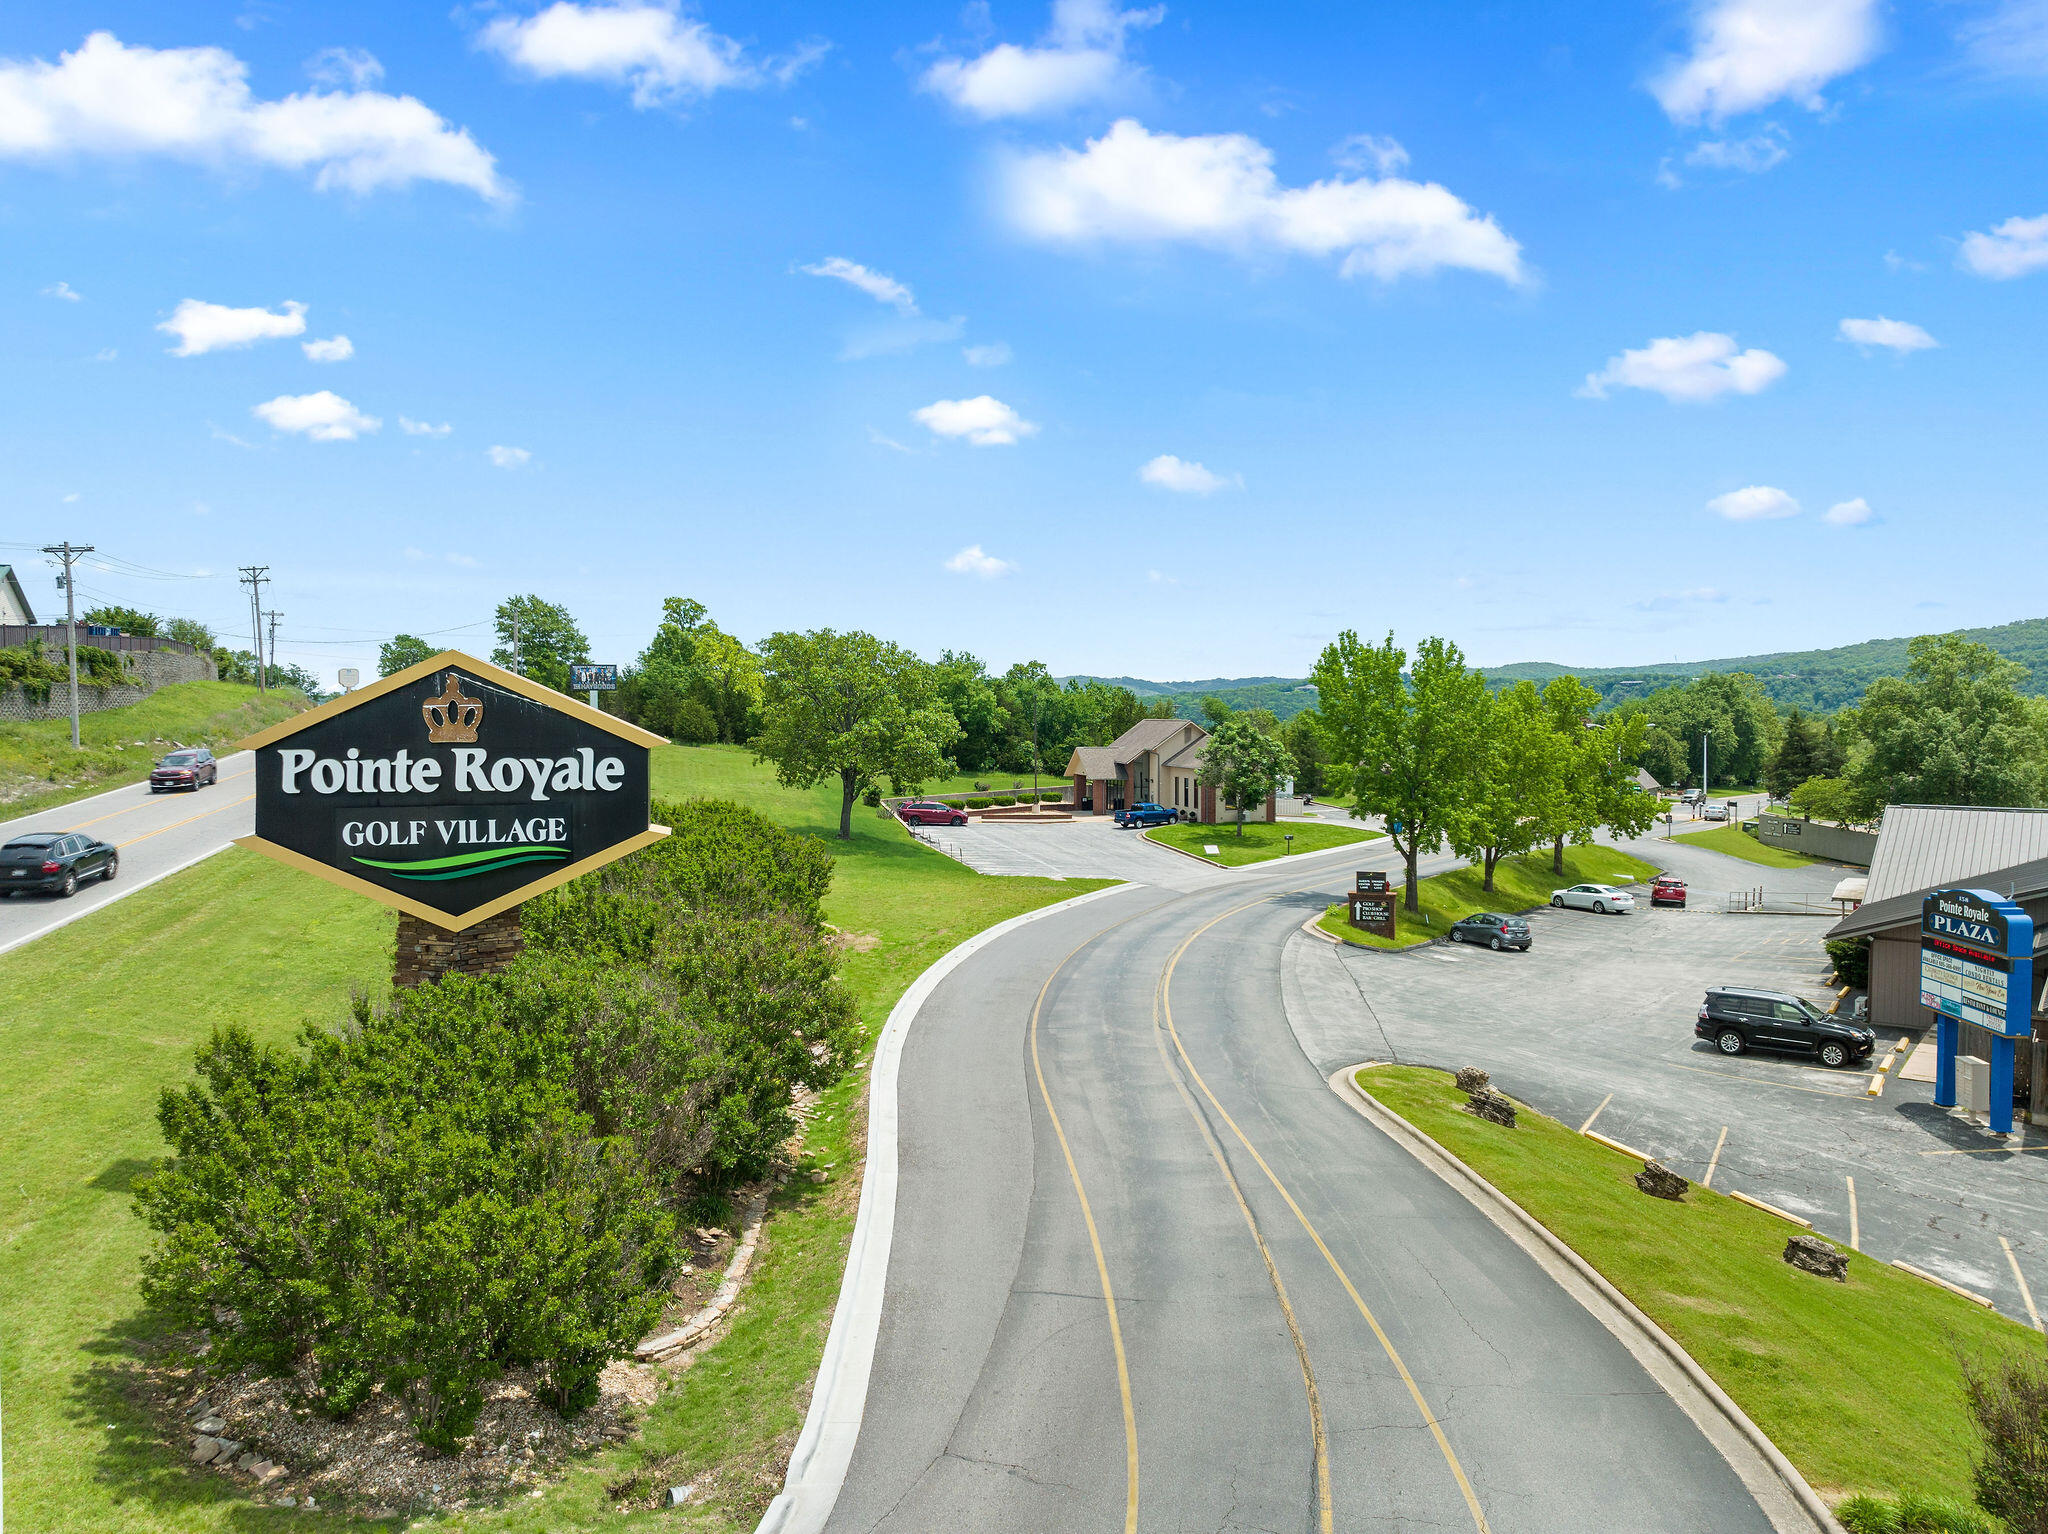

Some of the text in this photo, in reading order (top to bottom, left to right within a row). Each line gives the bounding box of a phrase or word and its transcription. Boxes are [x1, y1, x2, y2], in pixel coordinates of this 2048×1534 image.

[277, 747, 626, 801] Pointe Royale
[342, 817, 568, 847] GOLF VILLAGE
[1940, 900, 1989, 922] Pointe Royale
[1934, 915, 1994, 944] PLAZA
[1934, 939, 1995, 962] Office Space Available
[1965, 970, 1981, 980] CONDO
[1983, 975, 2004, 986] RENTALS
[1975, 966, 1995, 976] NIGHTLY
